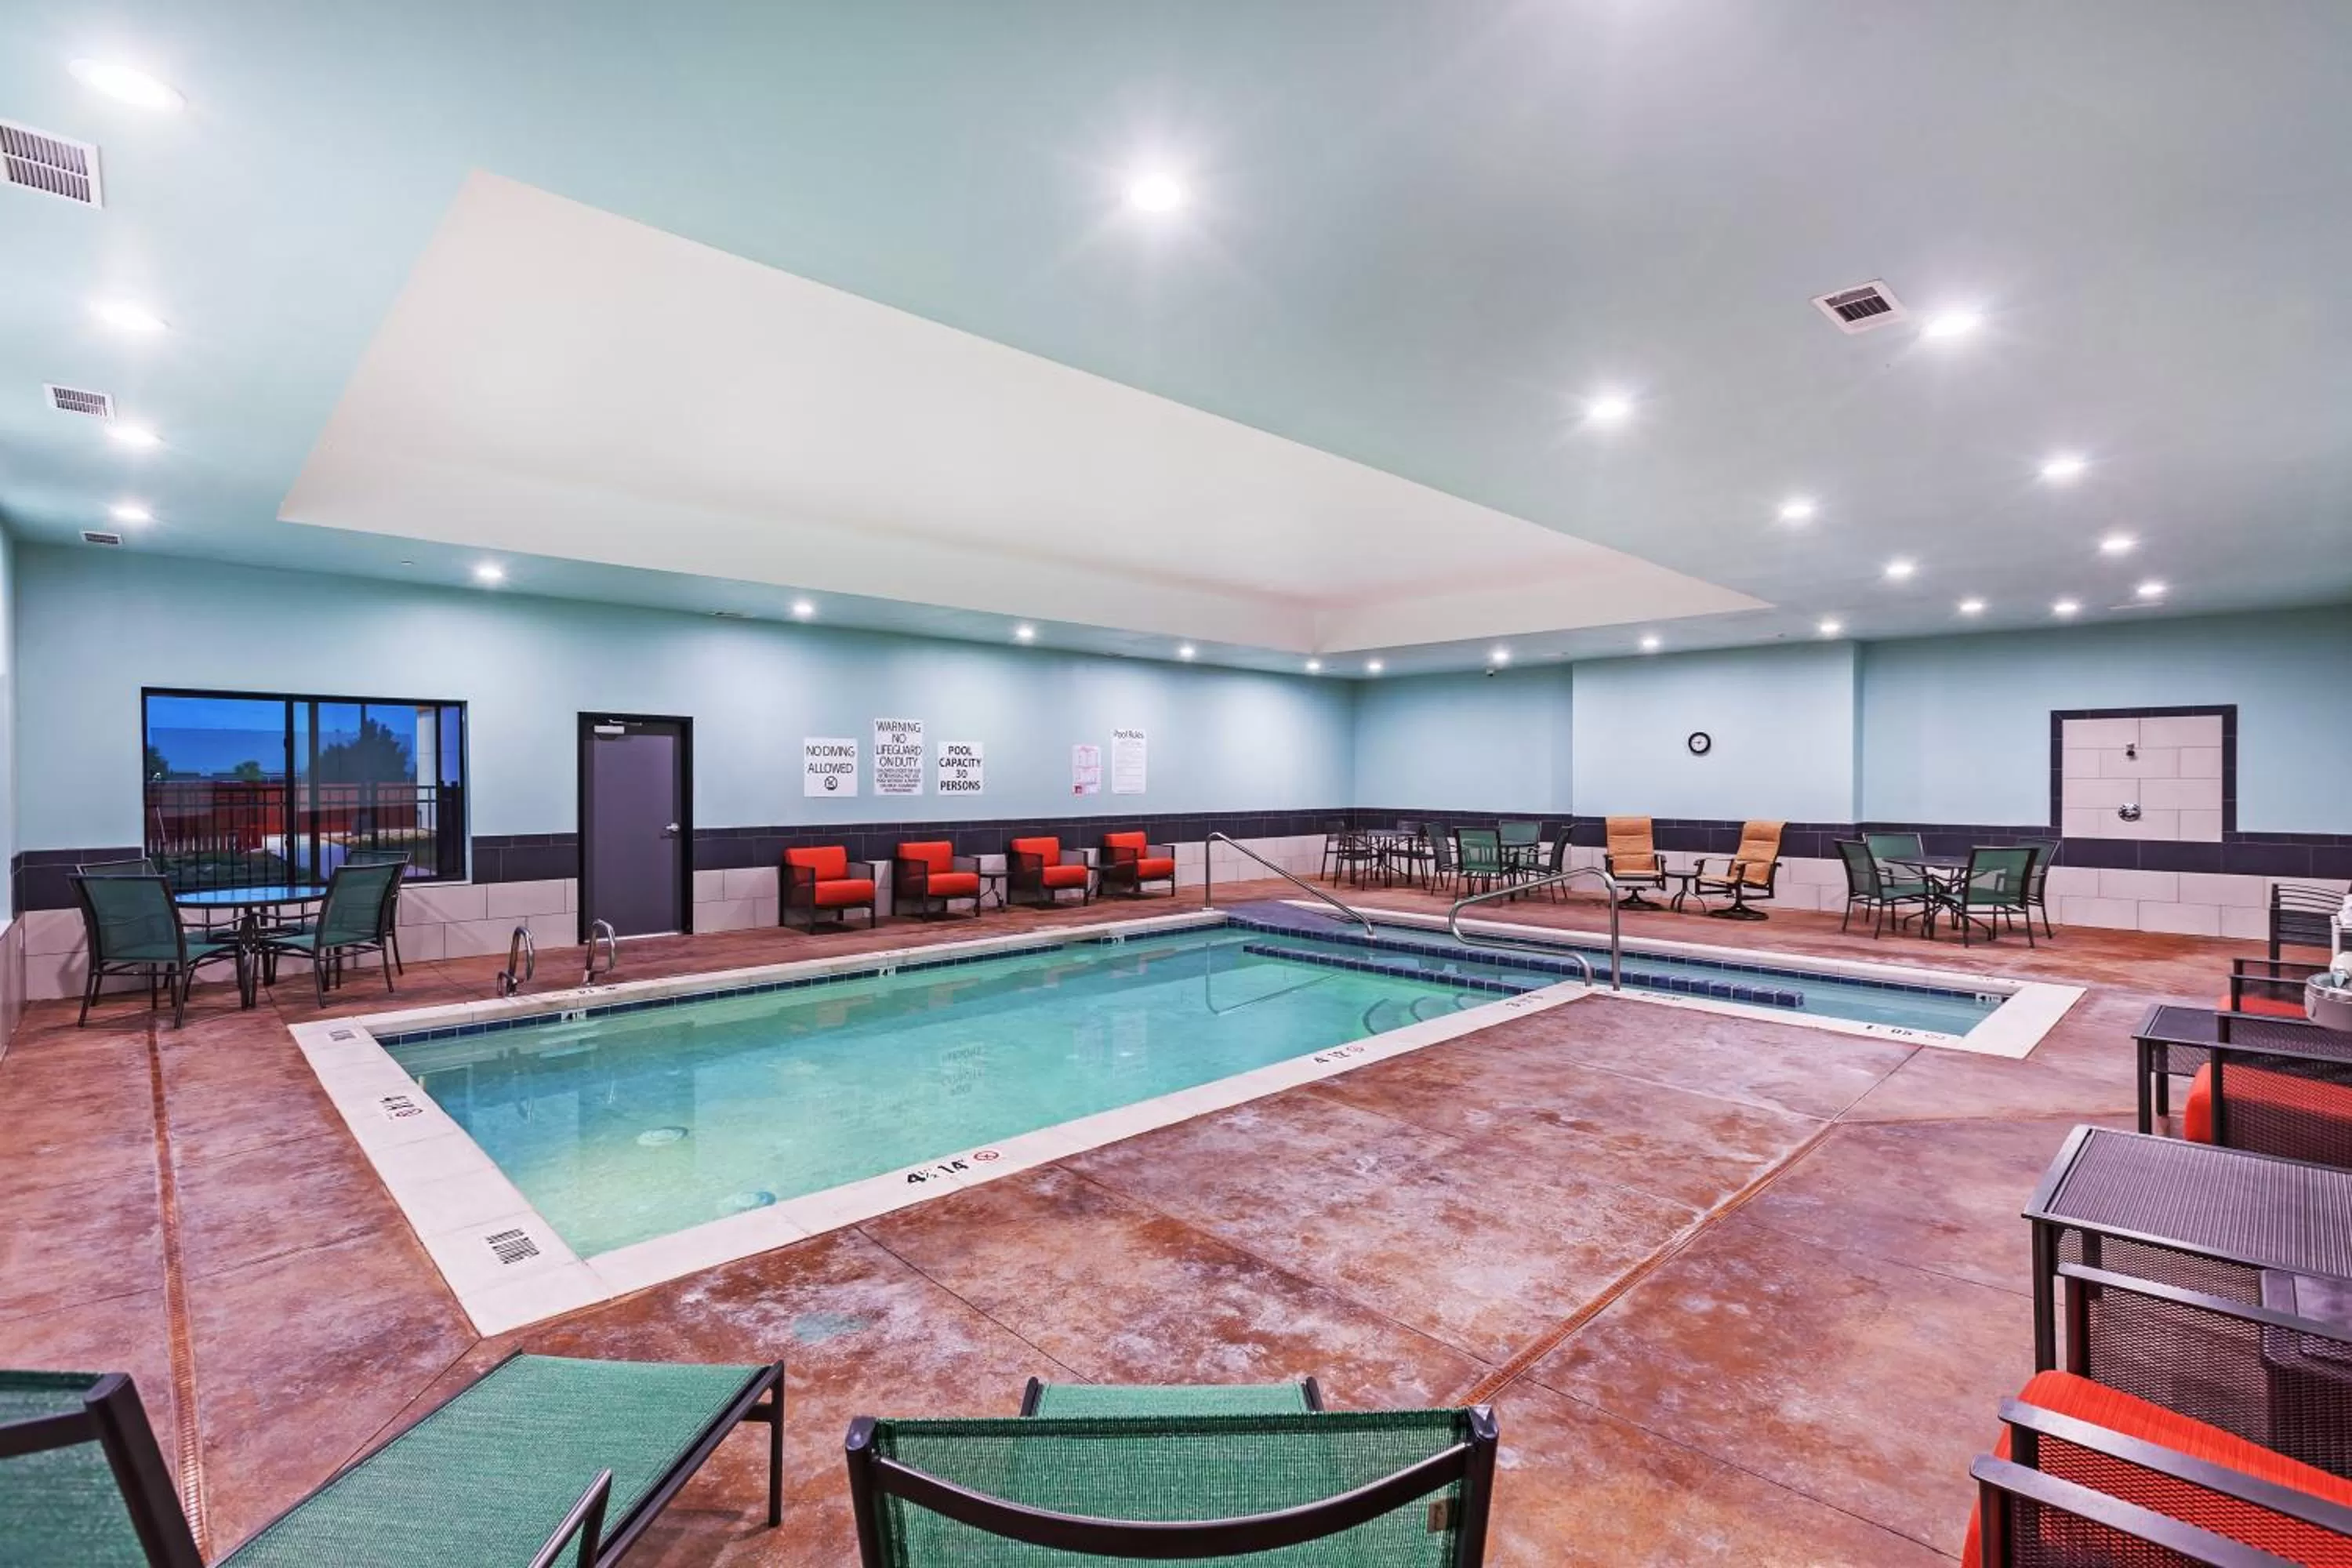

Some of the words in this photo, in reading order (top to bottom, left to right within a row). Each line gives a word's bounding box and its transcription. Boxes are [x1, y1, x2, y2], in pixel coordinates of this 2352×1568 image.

[876, 720, 920, 732] WARNING
[891, 733, 907, 744] NO
[1113, 730, 1128, 739] Pool
[806, 746, 822, 757] NO
[822, 746, 855, 757] DIVING
[876, 744, 922, 756] LIFEGUARD
[948, 746, 972, 756] POOL
[879, 756, 894, 767] ON
[895, 757, 918, 767] DUTY
[938, 757, 982, 768] CAPACITY
[808, 763, 854, 774] ALLOWED
[956, 769, 968, 779] 30
[940, 780, 981, 791] PERSONS
